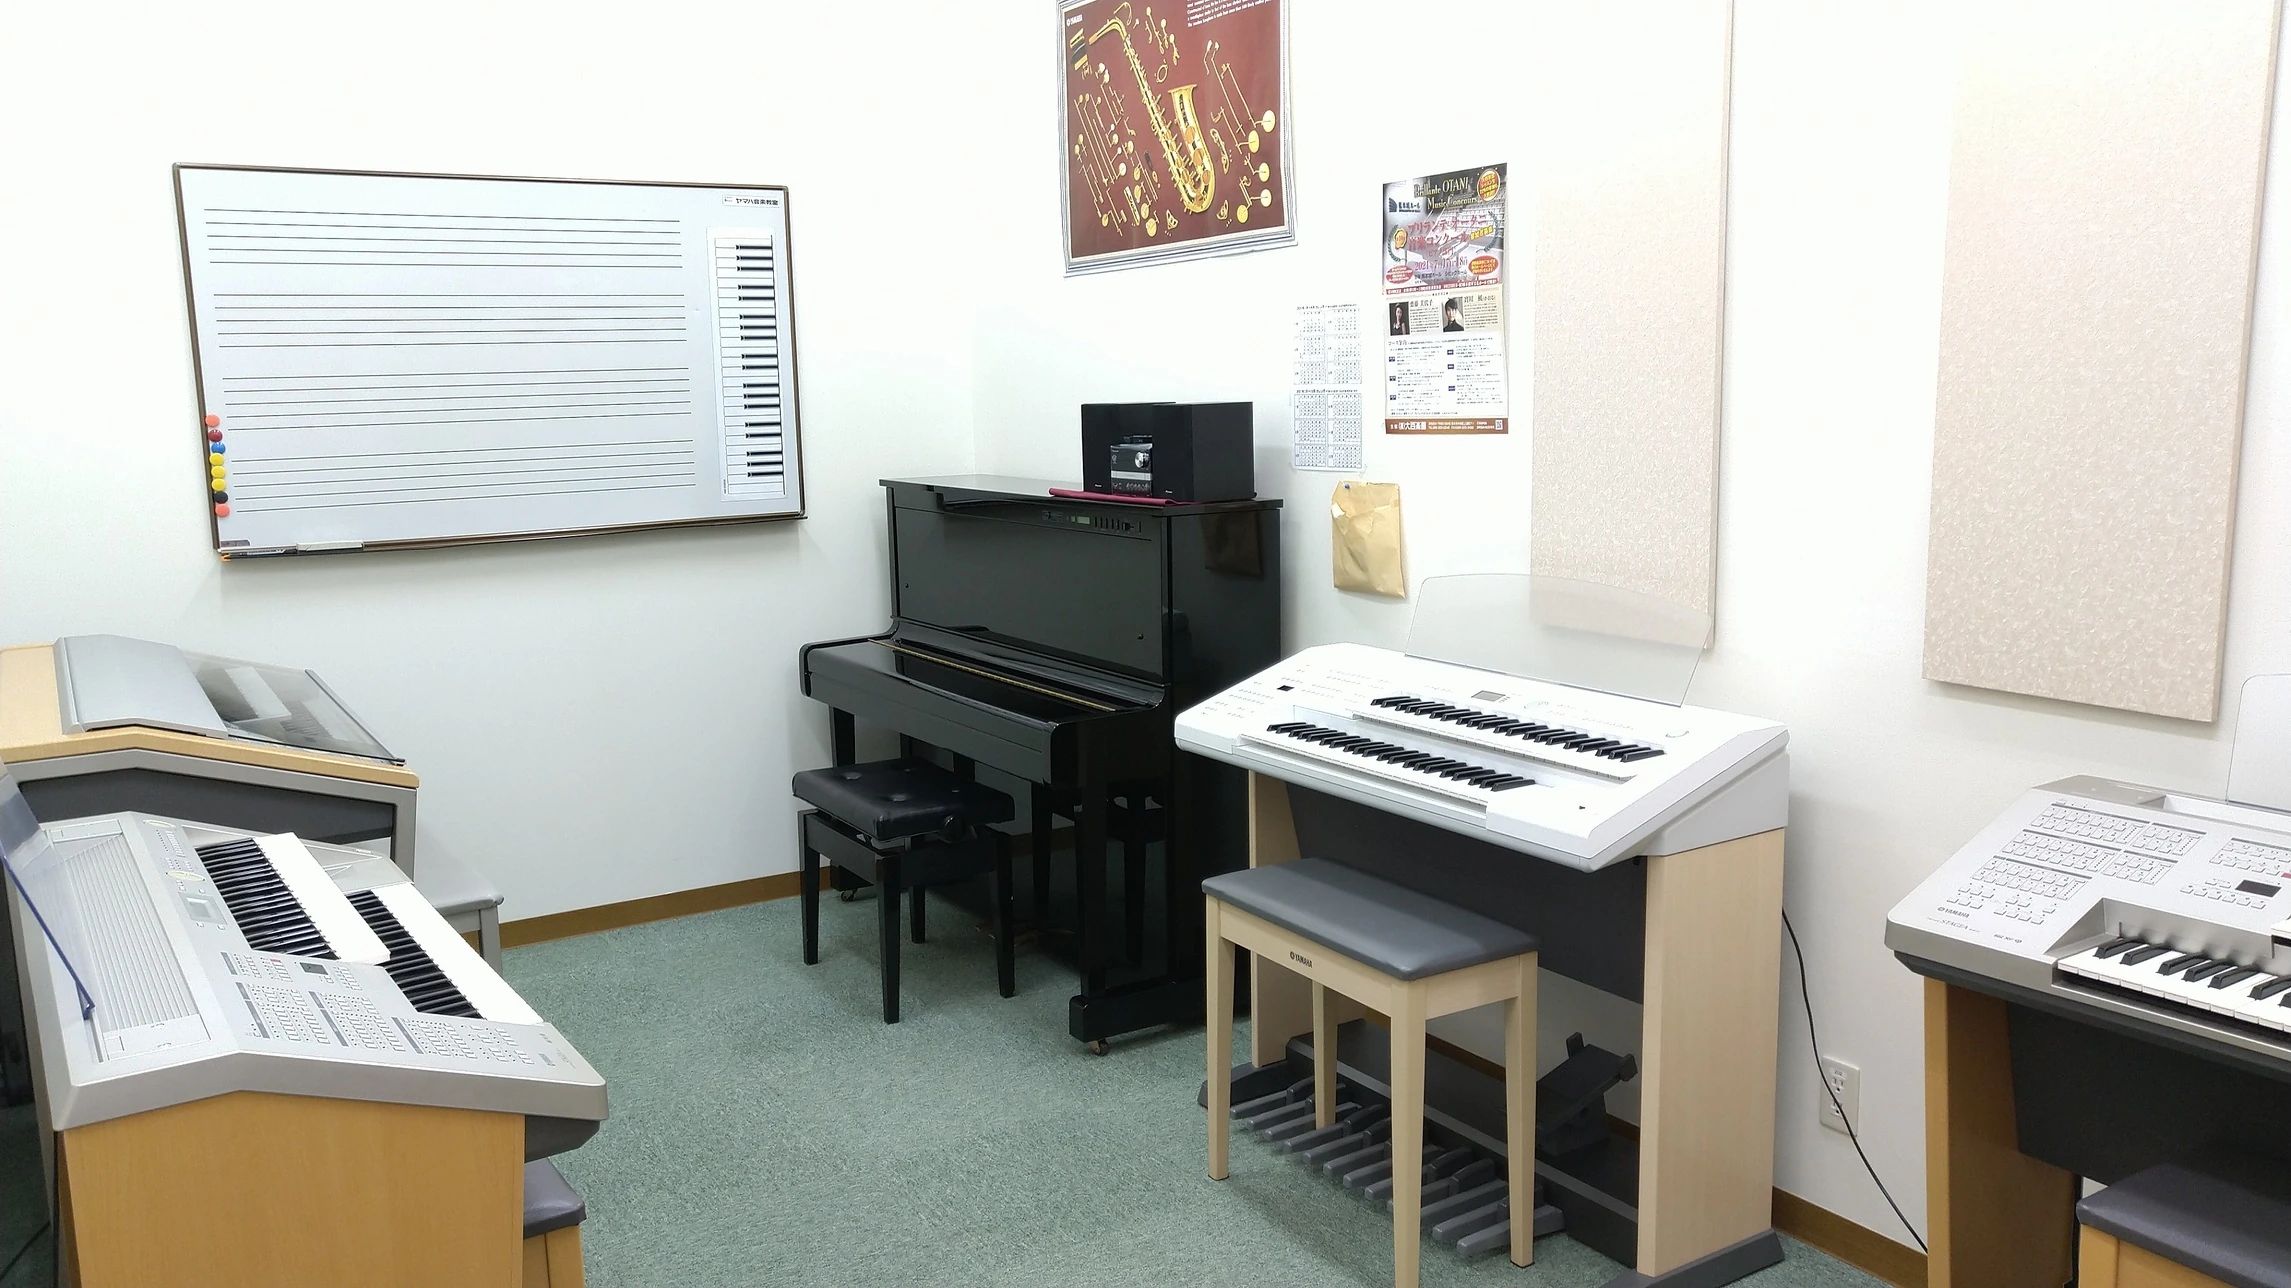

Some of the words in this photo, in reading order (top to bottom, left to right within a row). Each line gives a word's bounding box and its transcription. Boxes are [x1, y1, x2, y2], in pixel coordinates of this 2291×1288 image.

[1442, 176, 1469, 193] OTANI
[736, 198, 779, 206] ヤマハ音楽教室
[1428, 197, 1446, 209] Music
[1945, 908, 1970, 918] YAMAHA
[1940, 919, 1968, 930] STAGEA
[1295, 954, 1313, 968] YAMAHA
